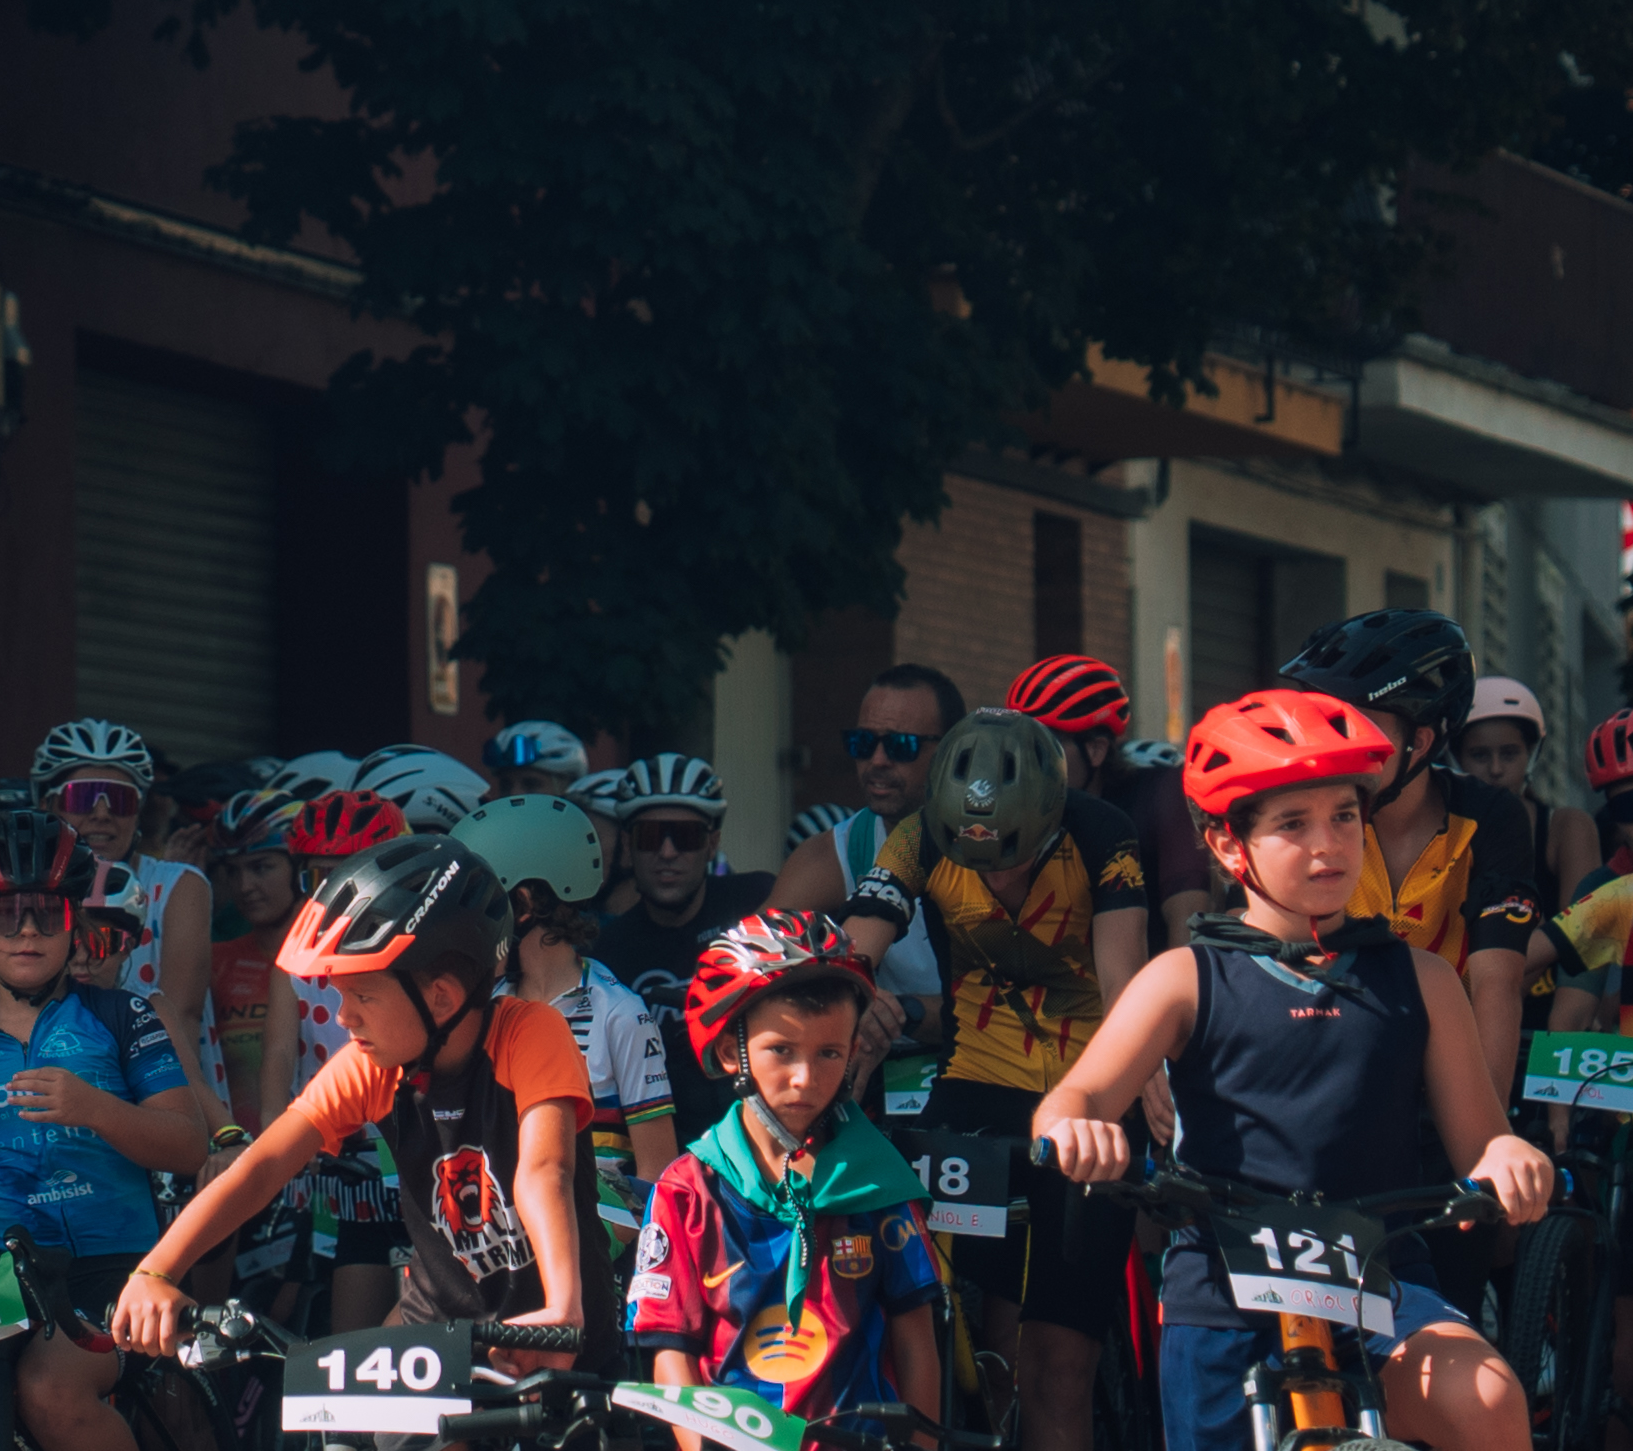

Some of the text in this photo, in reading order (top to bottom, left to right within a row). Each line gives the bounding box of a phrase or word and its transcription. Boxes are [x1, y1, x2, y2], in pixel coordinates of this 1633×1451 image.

[1368, 675, 1408, 702] hebo
[405, 860, 461, 934] CRATONI
[1290, 1008, 1341, 1018] TARMAK
[27, 1182, 94, 1205] ambisist
[912, 1154, 970, 1197] 18
[929, 1210, 963, 1230] NIOL
[1251, 1226, 1365, 1281] 121
[317, 1345, 443, 1391] 140
[656, 1384, 775, 1440] 190
[684, 1412, 735, 1441] HUGO
